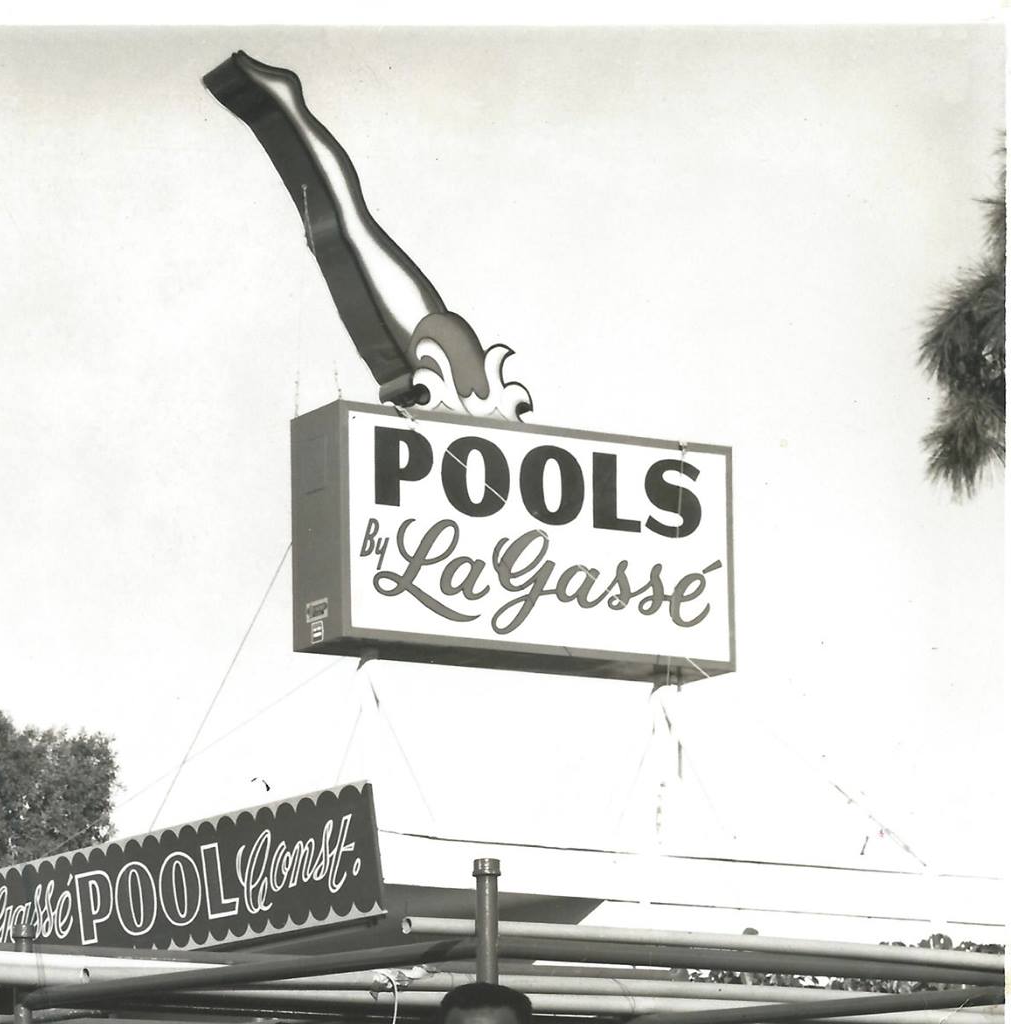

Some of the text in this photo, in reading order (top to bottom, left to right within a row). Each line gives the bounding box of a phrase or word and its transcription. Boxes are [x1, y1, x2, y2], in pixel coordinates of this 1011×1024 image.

[374, 425, 702, 538] POOLS
[359, 517, 389, 570] By
[73, 842, 240, 946] POOL
[238, 813, 362, 915] Const.
